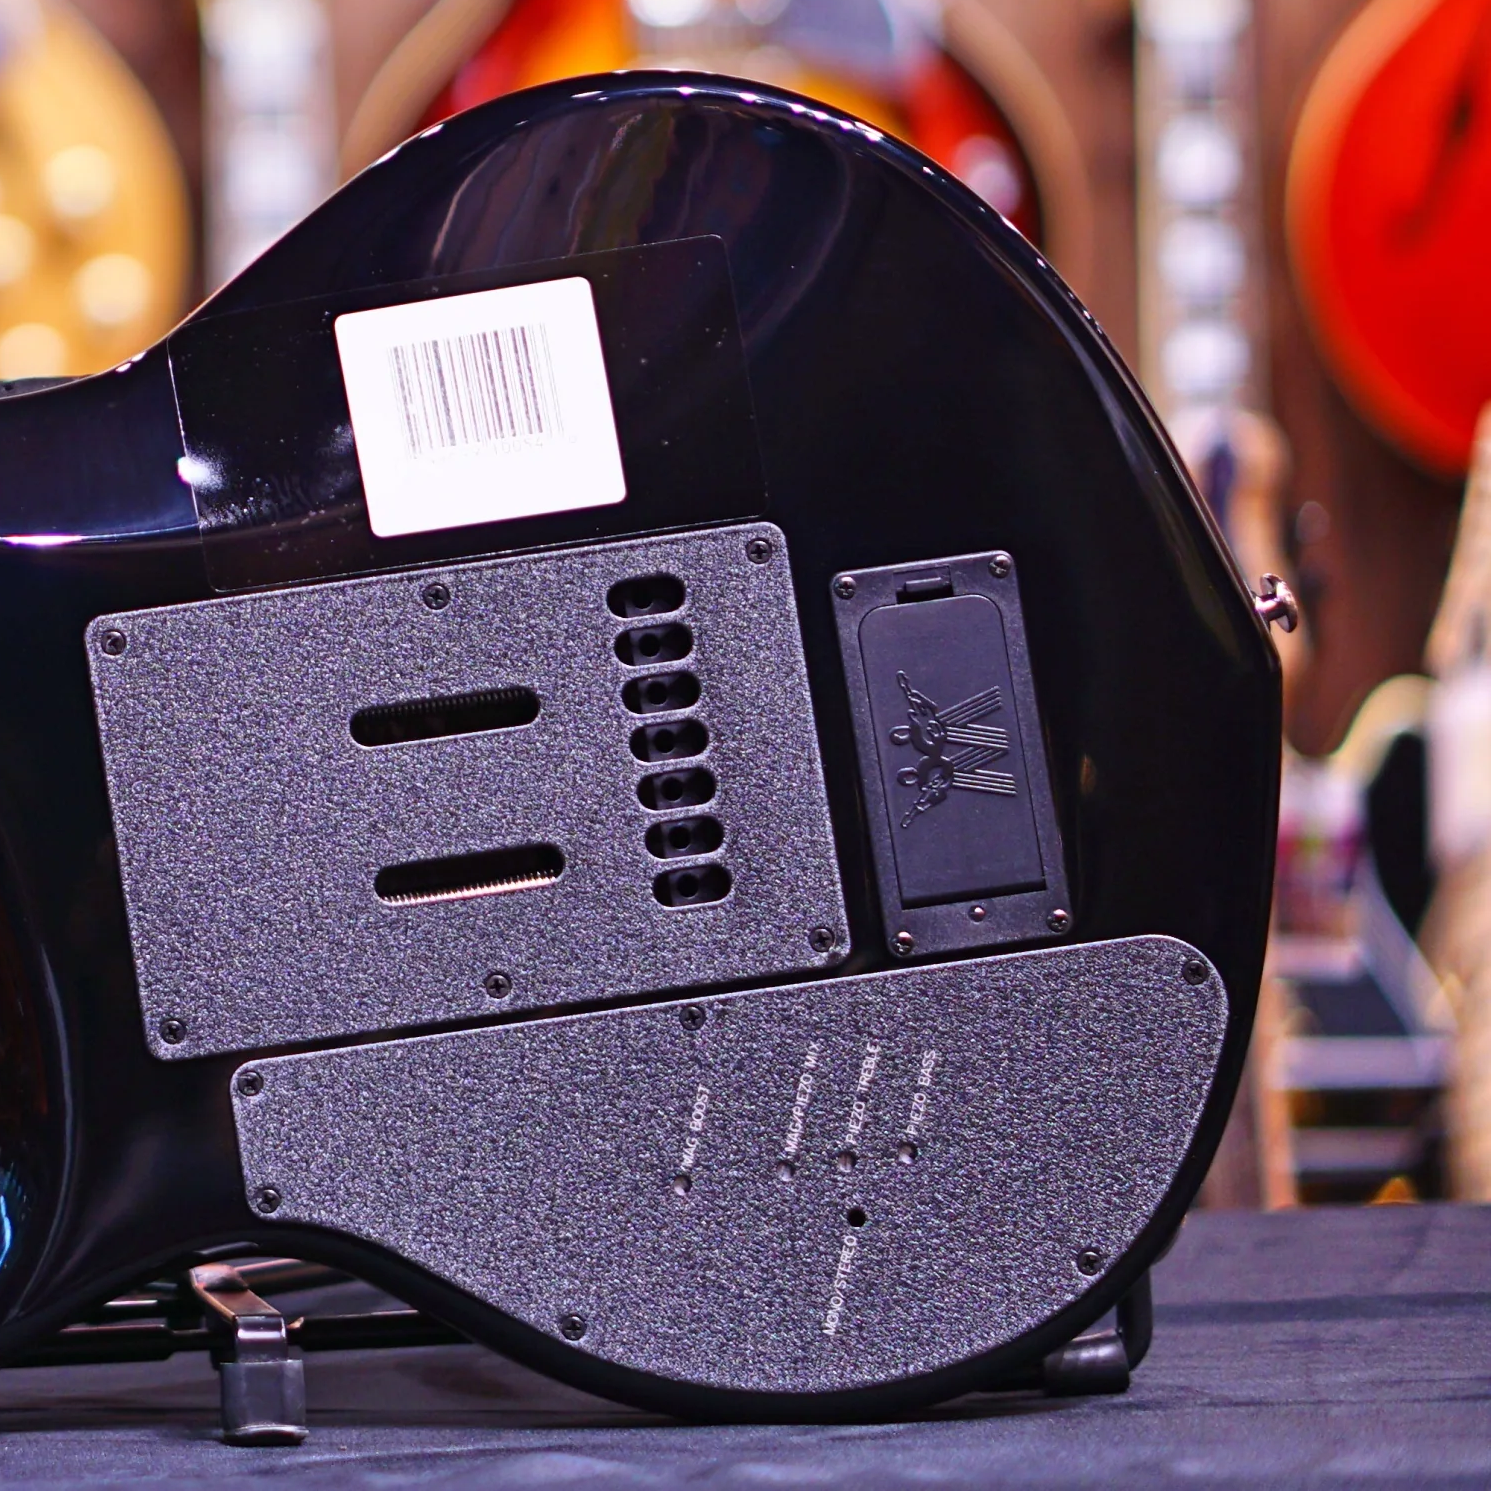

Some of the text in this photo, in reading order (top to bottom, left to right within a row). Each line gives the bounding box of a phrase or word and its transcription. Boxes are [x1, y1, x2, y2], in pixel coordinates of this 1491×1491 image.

[681, 1083, 710, 1171] MAG BOOST
[785, 1041, 821, 1153] MAG/PIEZO MIX
[845, 1041, 881, 1145] PIEZO TREBLE
[905, 1049, 937, 1136] PIEZO BASS
